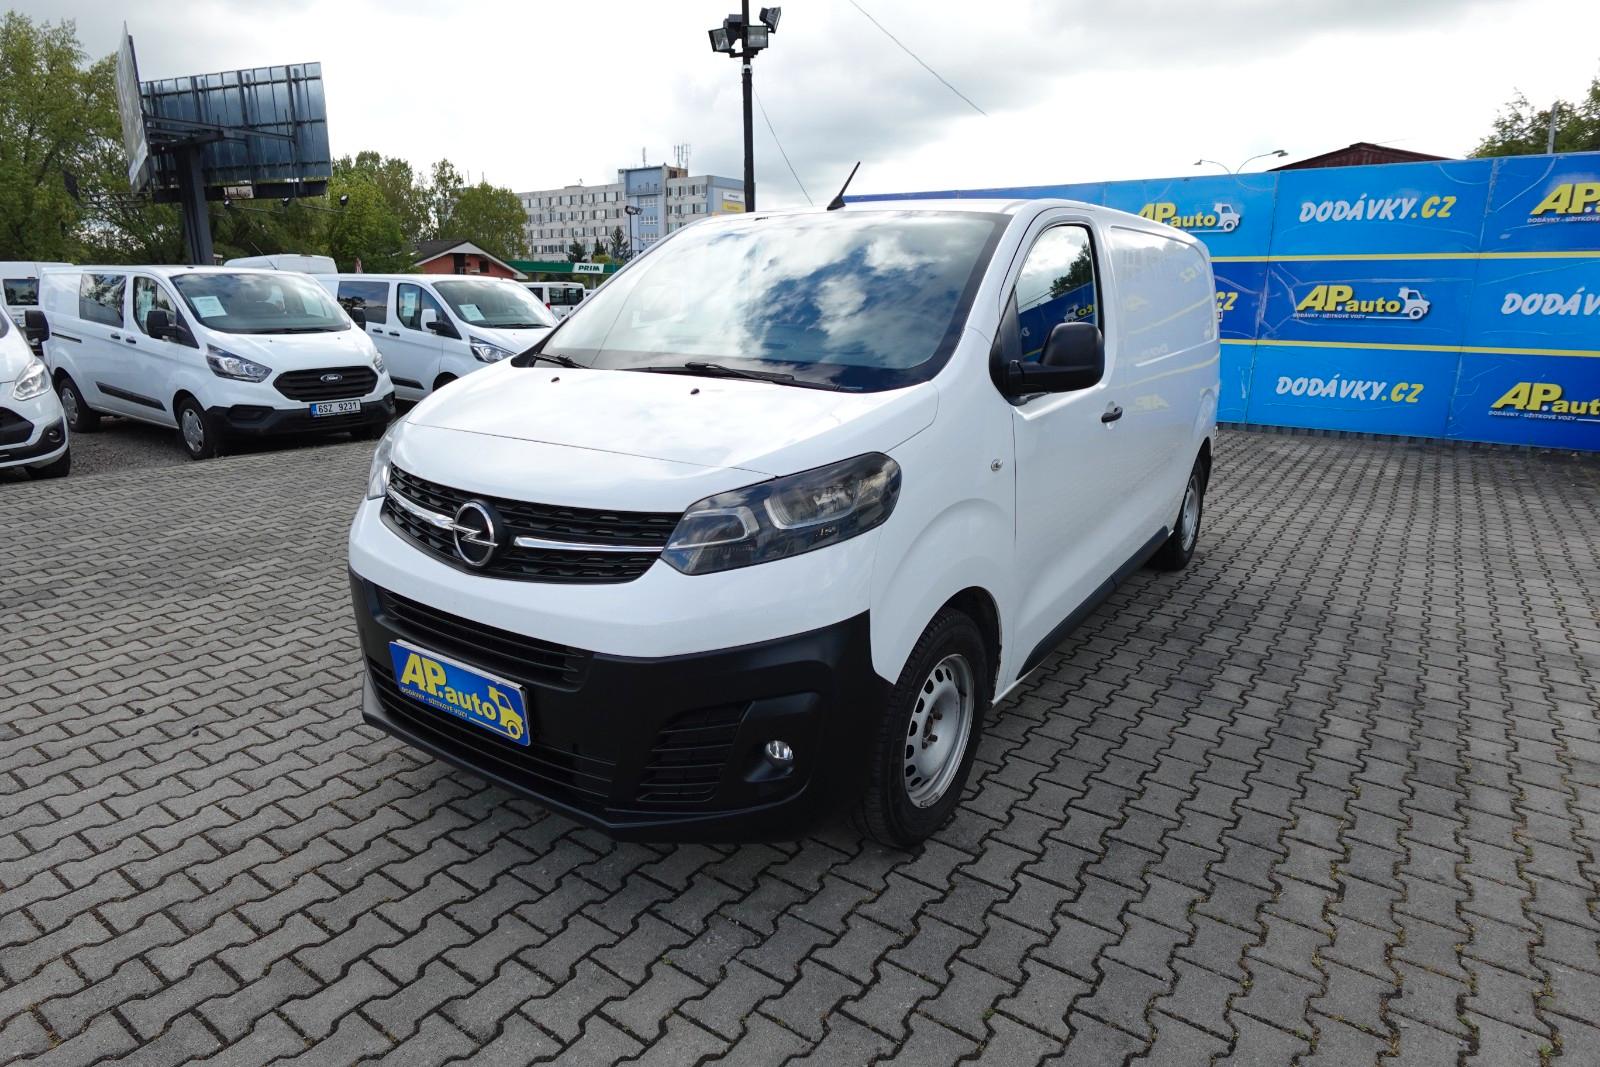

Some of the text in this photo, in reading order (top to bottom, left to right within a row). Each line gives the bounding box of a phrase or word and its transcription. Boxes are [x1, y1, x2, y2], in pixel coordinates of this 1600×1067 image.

[1299, 193, 1457, 222] DODÁVKY.CZ
[1529, 182, 1600, 215] AP.
[1296, 285, 1400, 313] AP.auto
[1501, 286, 1600, 315] DODÁV
[1275, 374, 1424, 403] DODÁVKY.CZ
[318, 404, 333, 413] 6SZ
[338, 402, 357, 411] 9231
[400, 653, 497, 720] AP.auto
